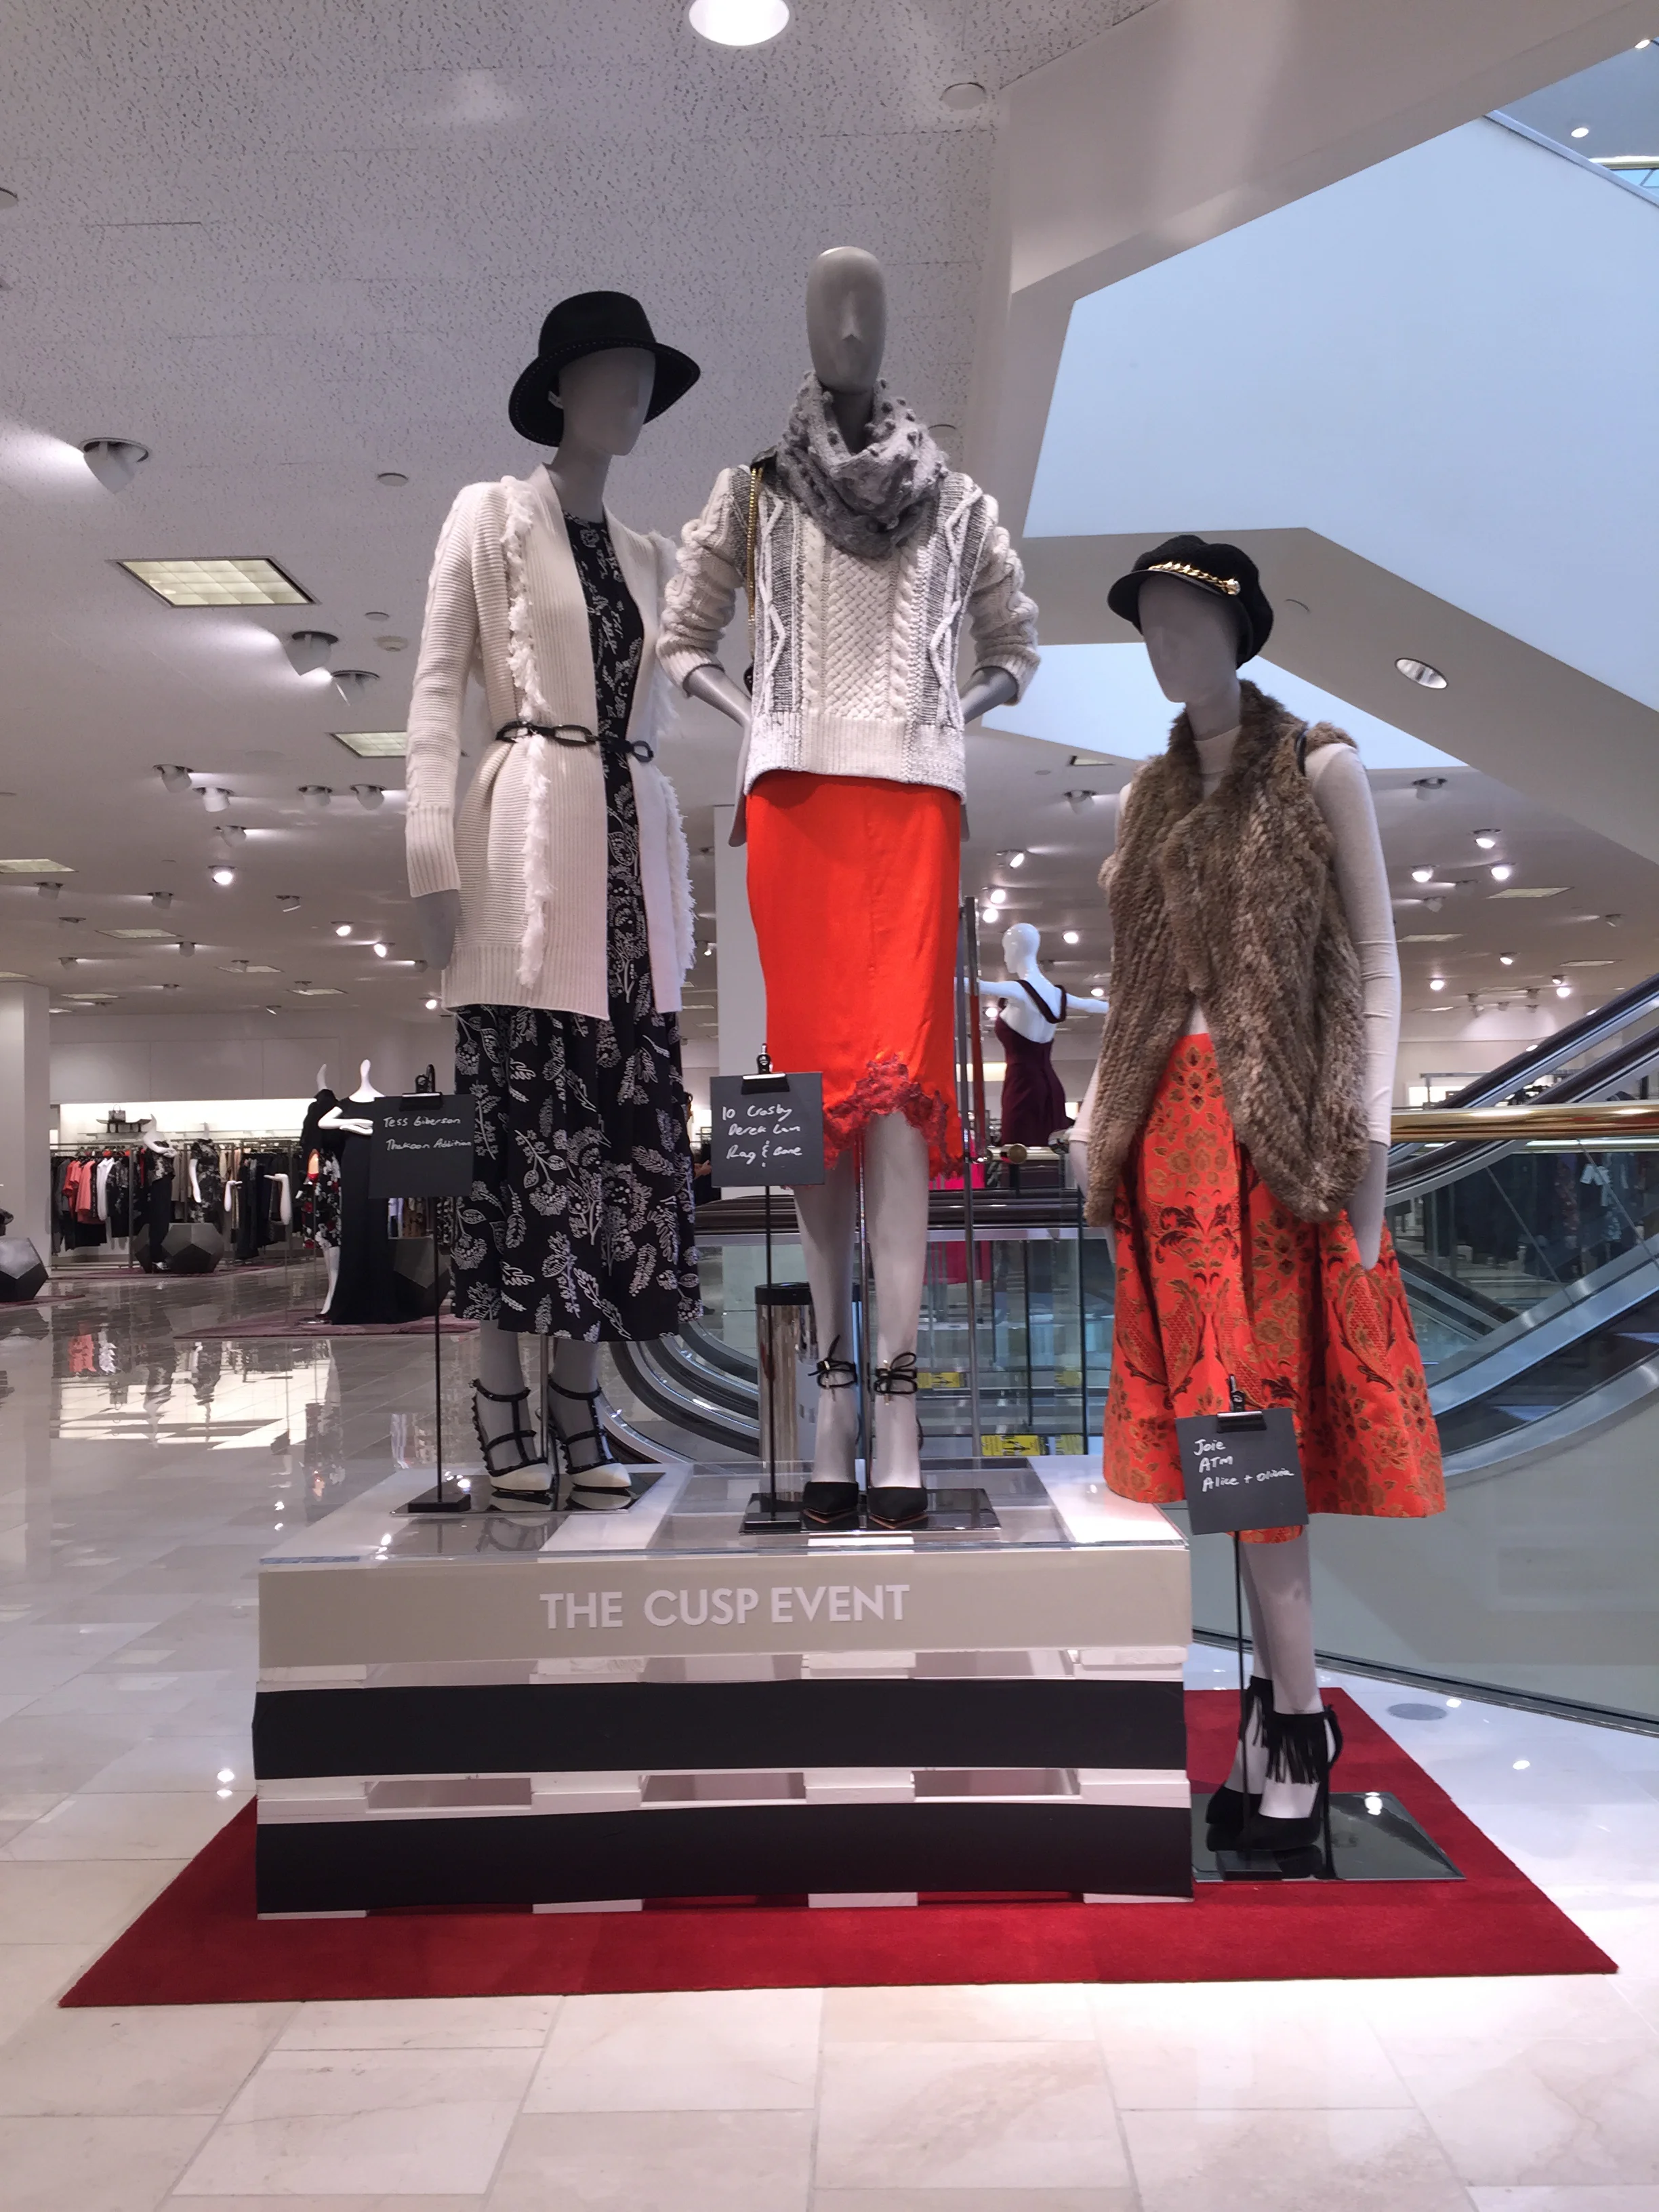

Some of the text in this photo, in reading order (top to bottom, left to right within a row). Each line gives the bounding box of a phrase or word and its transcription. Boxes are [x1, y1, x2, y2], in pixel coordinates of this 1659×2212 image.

[722, 1104, 792, 1122] 10 Crosby
[383, 1117, 408, 1128] Tess
[728, 1123, 766, 1136] Derek
[726, 1144, 756, 1165] Rag
[1193, 1439, 1227, 1456] Joie
[1198, 1456, 1233, 1473] ATM
[1202, 1476, 1240, 1492] Alice
[1243, 1475, 1253, 1483] +
[539, 1584, 910, 1630] THE CUSP EVENT
